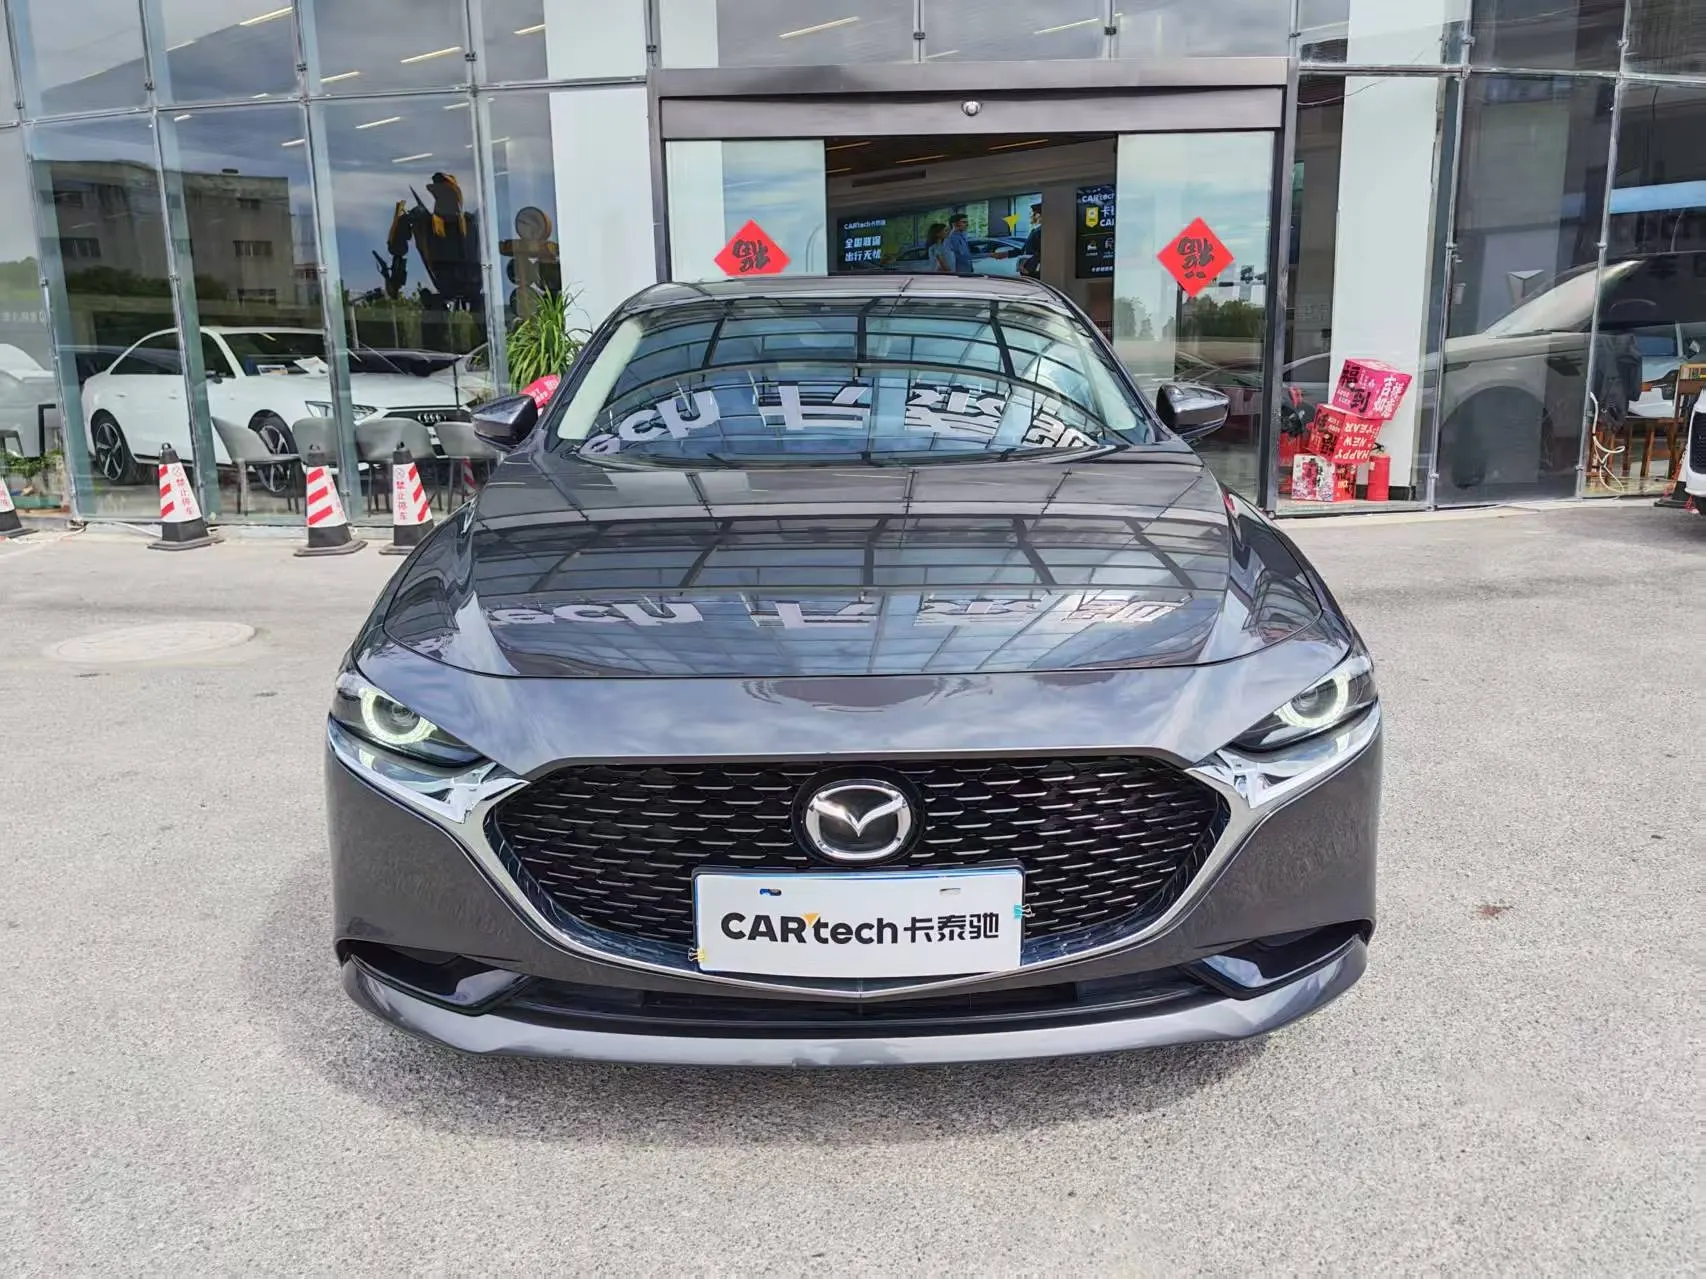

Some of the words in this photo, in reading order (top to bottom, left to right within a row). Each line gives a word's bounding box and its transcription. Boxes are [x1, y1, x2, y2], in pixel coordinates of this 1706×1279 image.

[1344, 423, 1373, 433] YEAR
[1343, 436, 1367, 447] NEW
[1334, 449, 1369, 459] HAPPY
